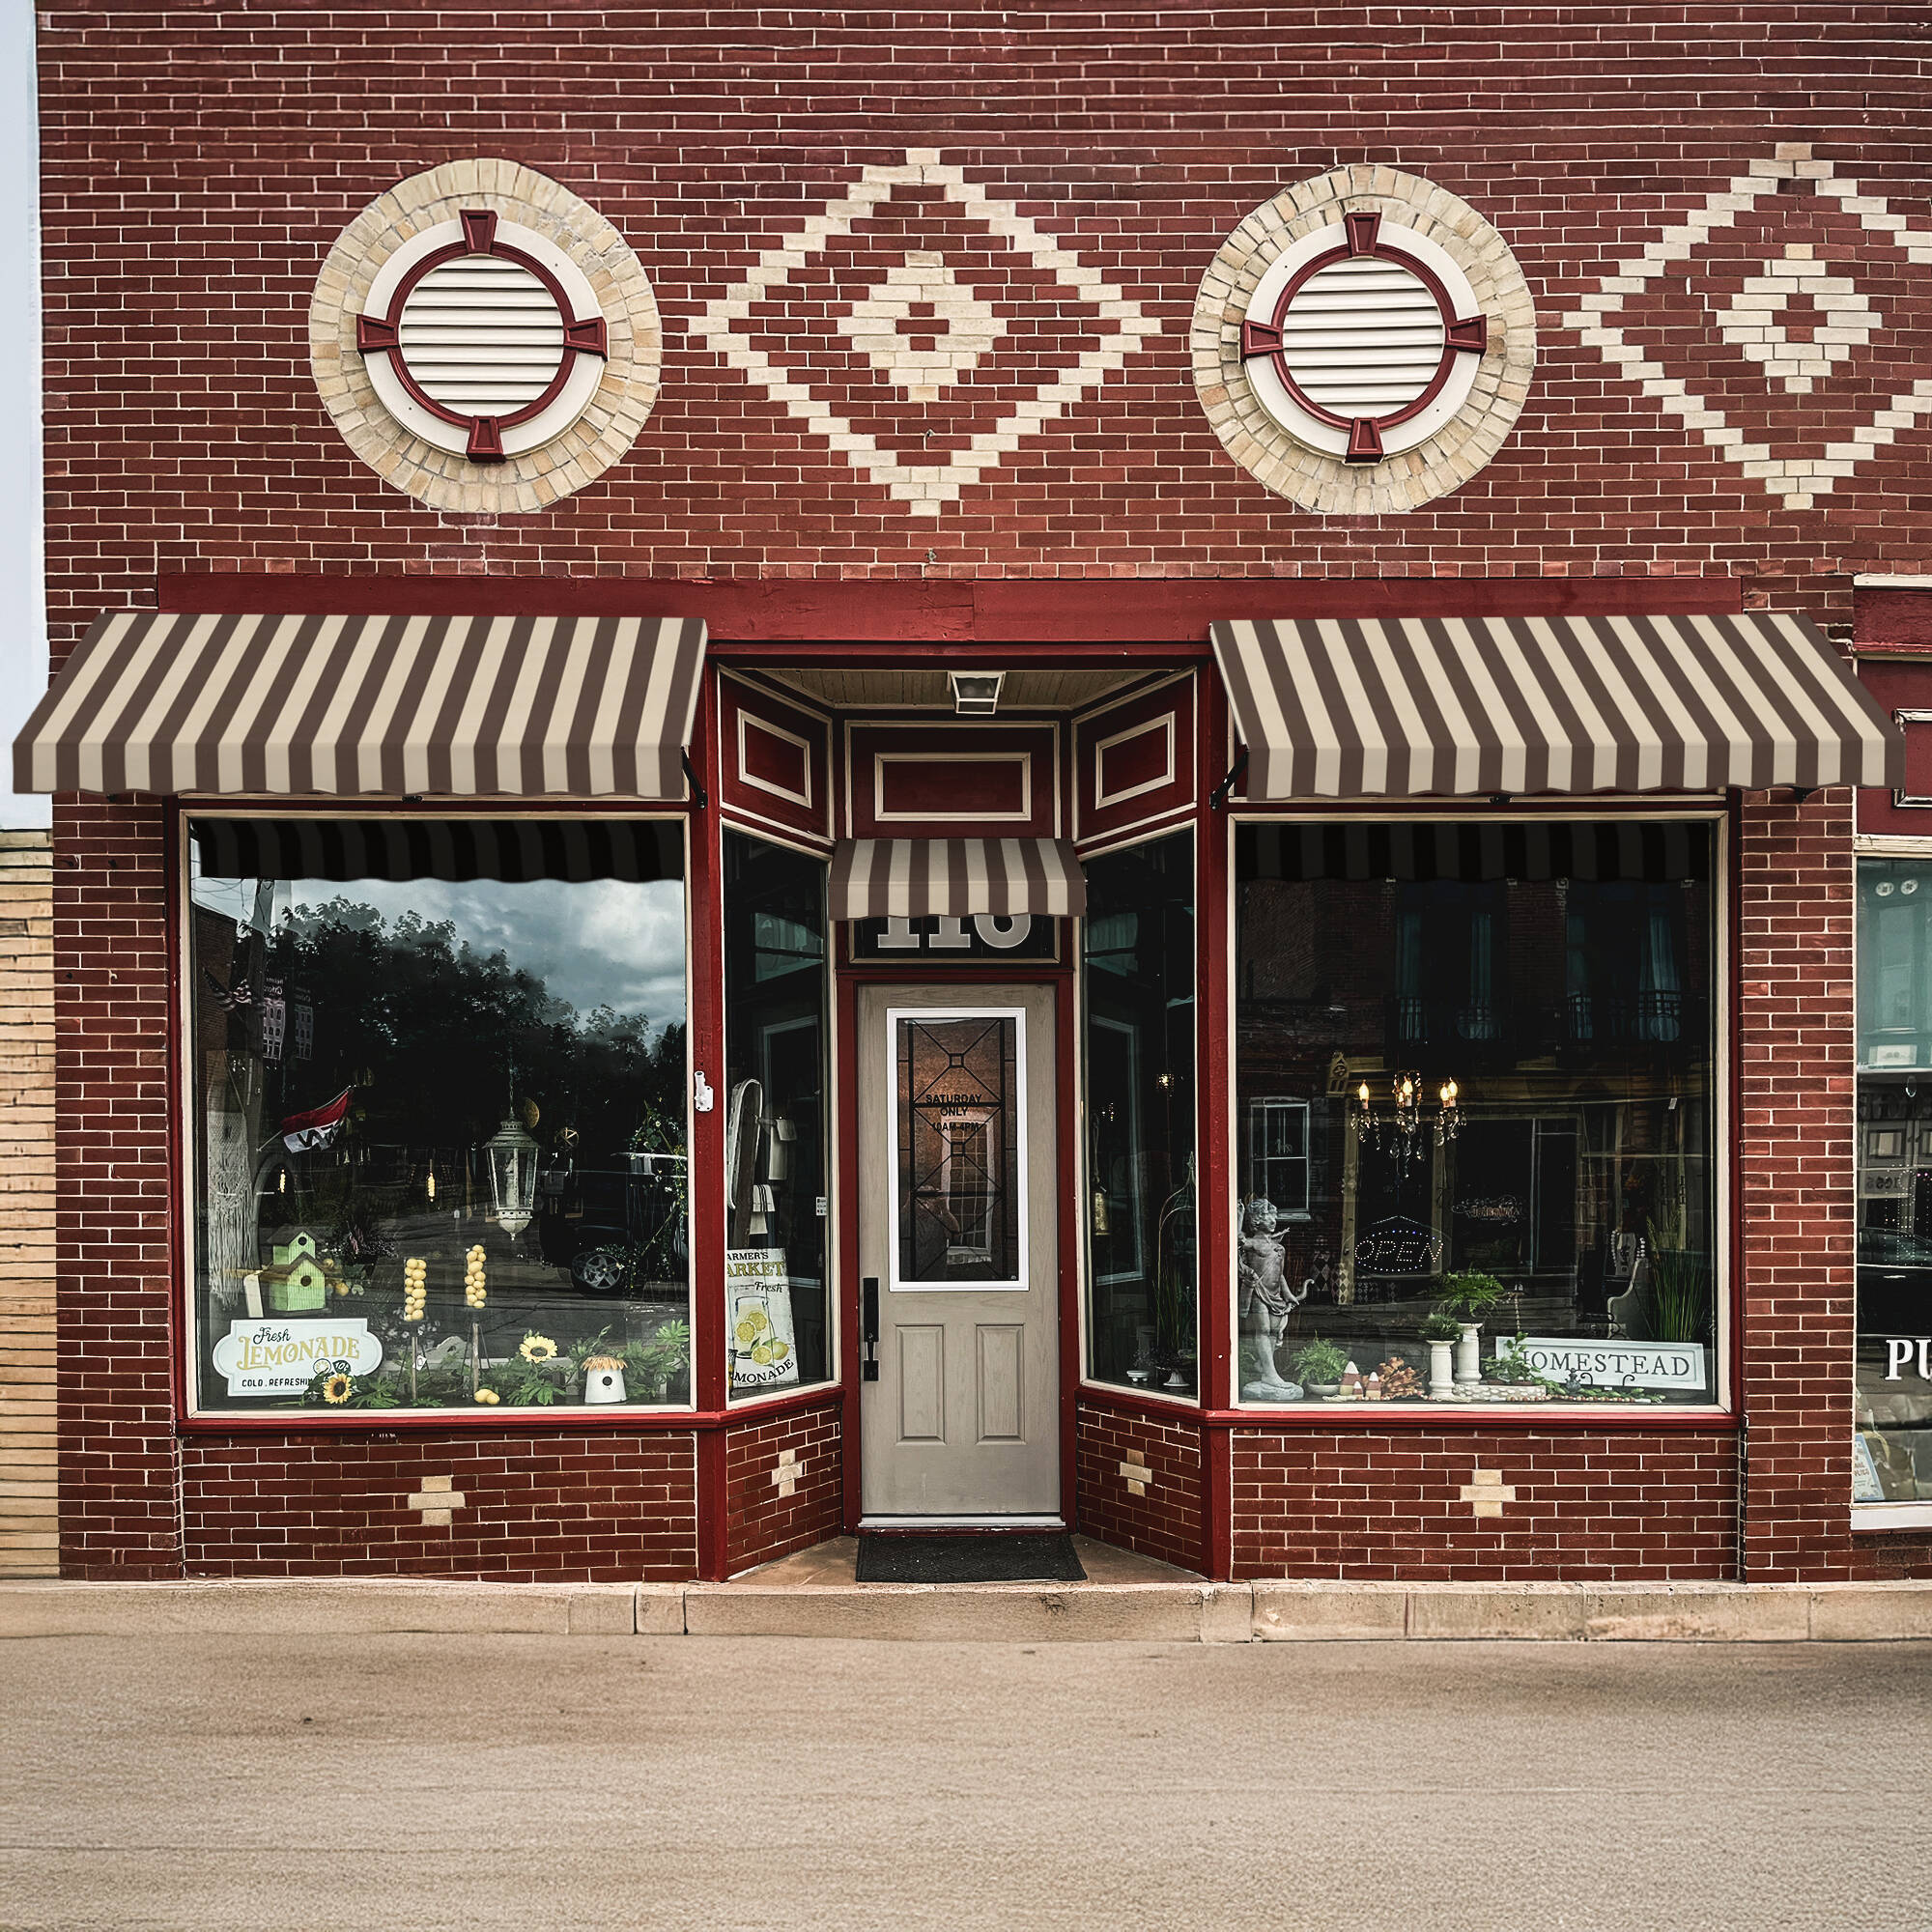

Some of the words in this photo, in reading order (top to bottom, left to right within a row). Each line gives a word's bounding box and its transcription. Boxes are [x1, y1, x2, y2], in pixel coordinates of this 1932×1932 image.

[925, 1094, 982, 1105] SATURDAY
[940, 1106, 968, 1116] ONLY
[727, 1252, 770, 1262] ARMER'S
[1354, 1239, 1444, 1263] OPEN
[727, 1262, 785, 1278] ARKET
[754, 1281, 783, 1293] Fresh
[253, 1327, 291, 1345] Fresh
[237, 1335, 360, 1371] LEMONADE
[733, 1359, 795, 1383] MONADE
